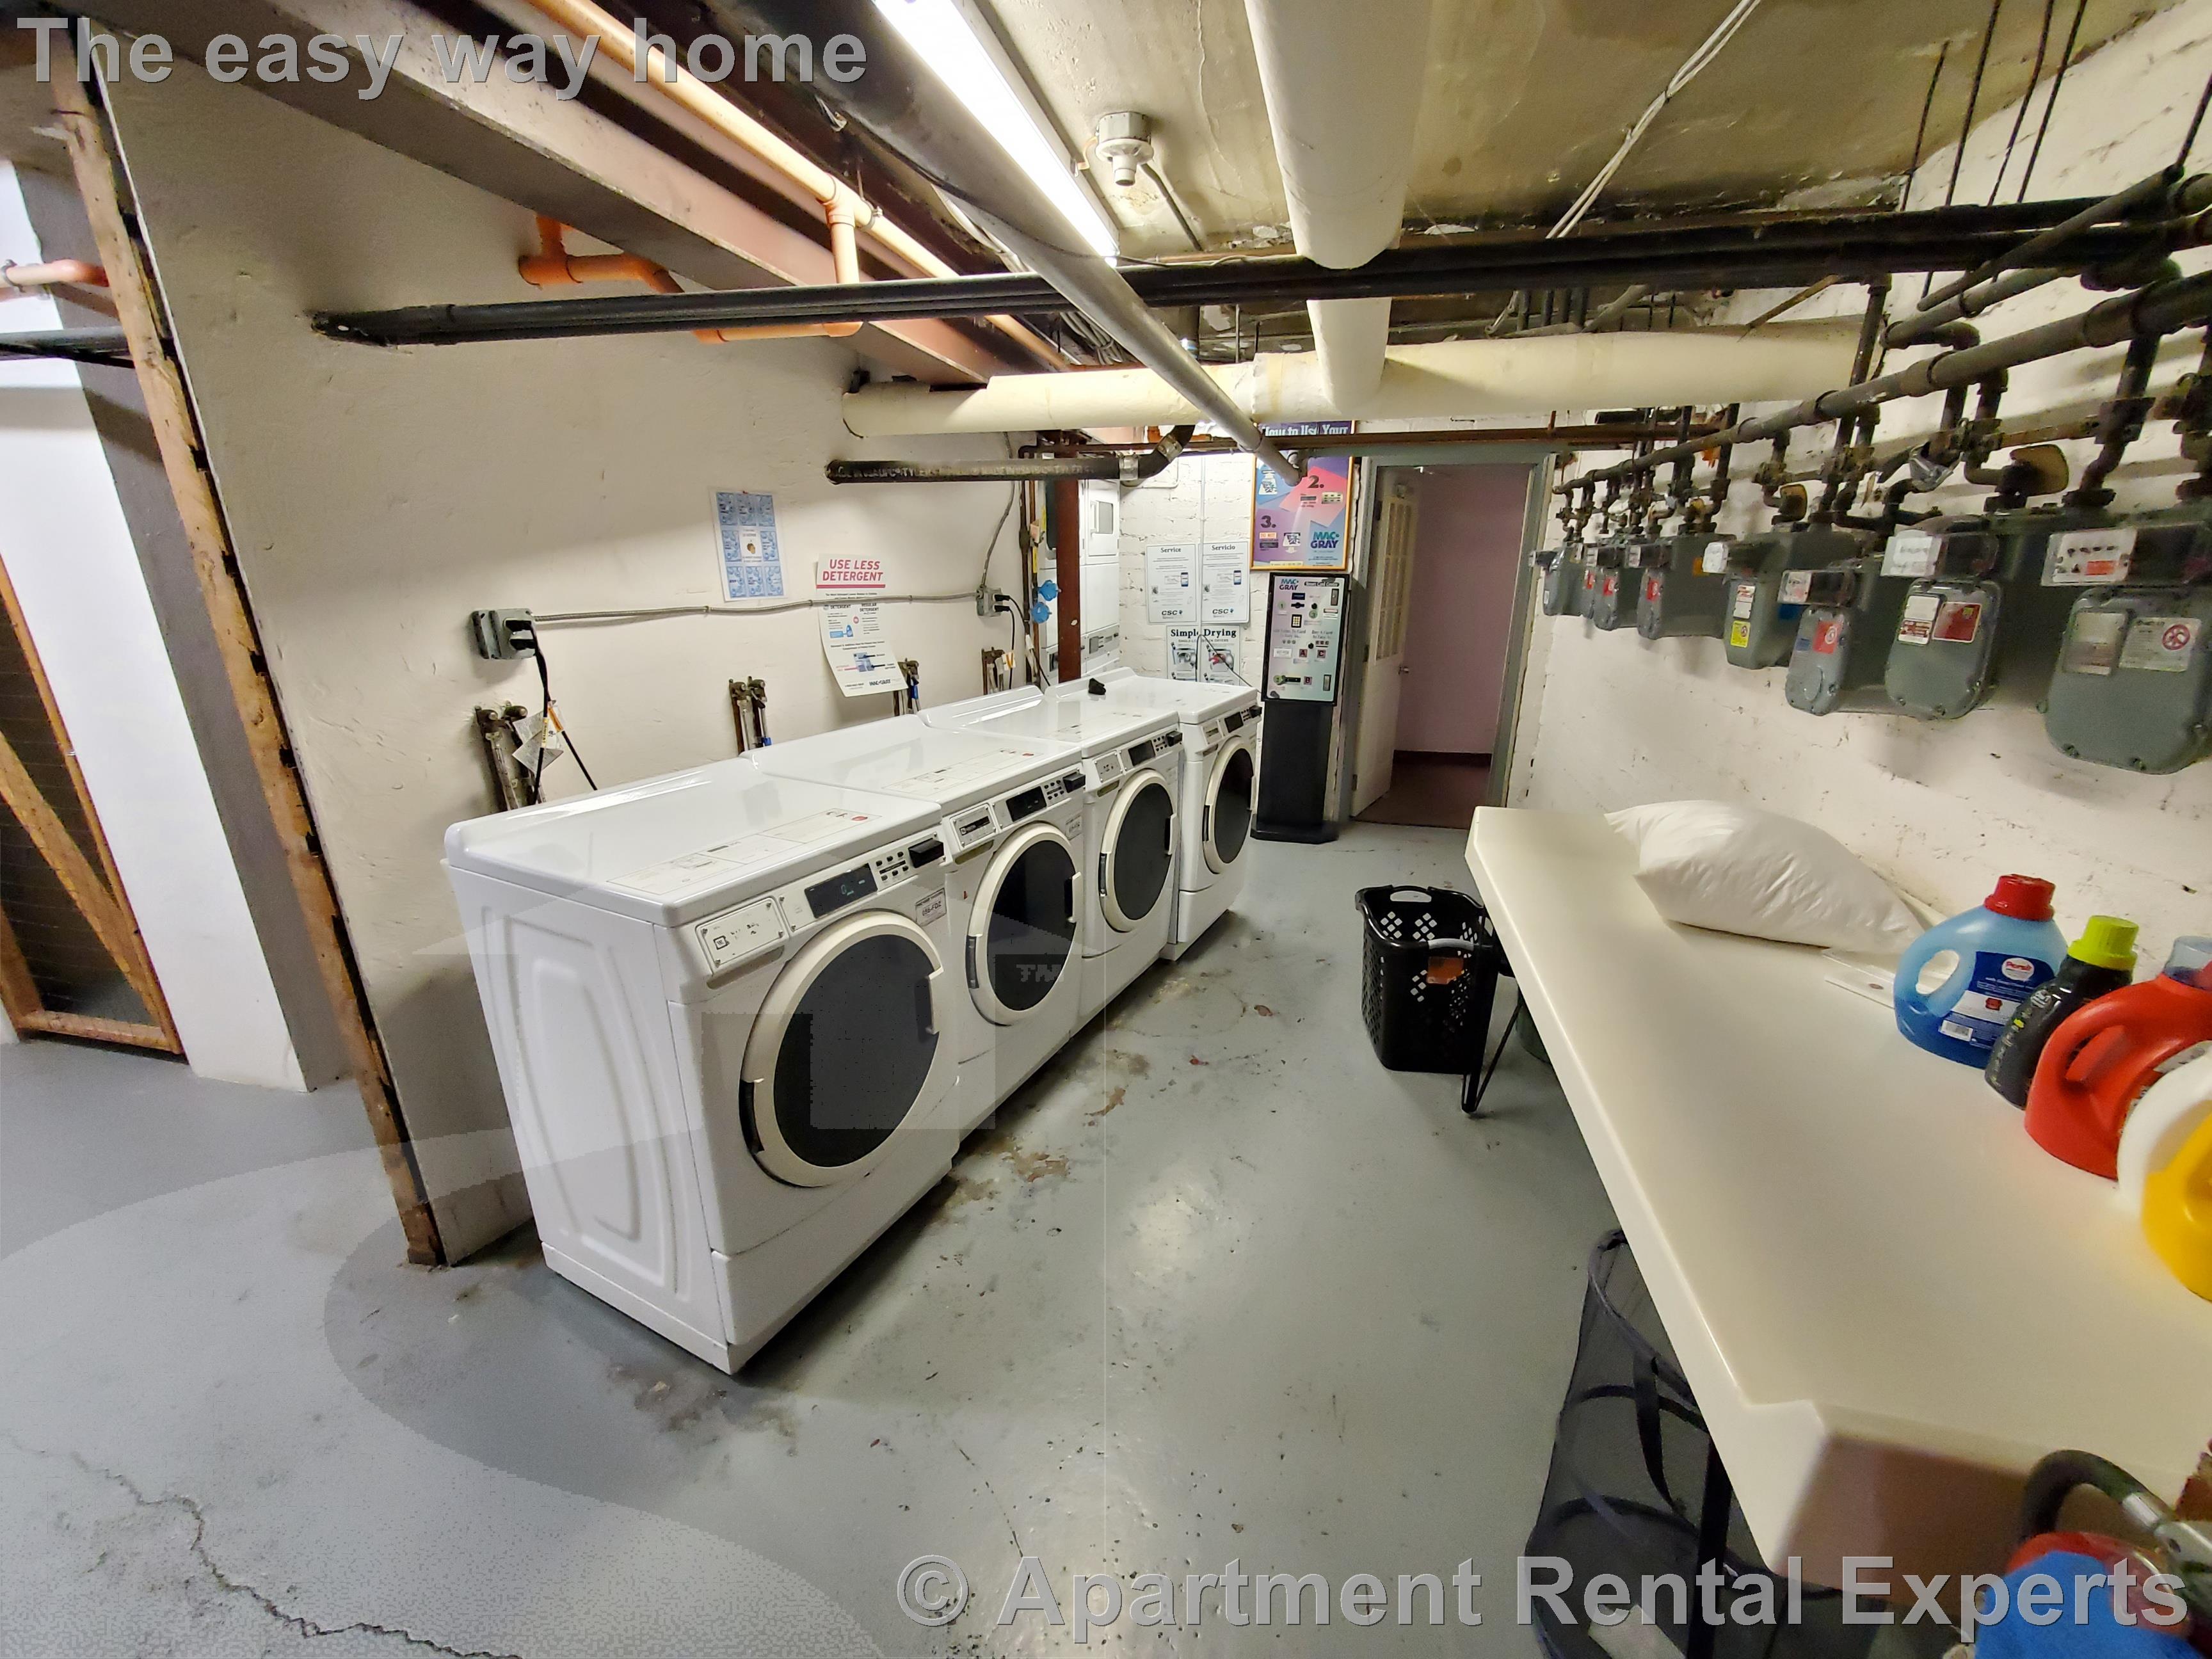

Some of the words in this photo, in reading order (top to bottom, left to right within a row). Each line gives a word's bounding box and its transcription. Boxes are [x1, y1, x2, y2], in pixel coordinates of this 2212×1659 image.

[1310, 540, 1339, 549] GRAY
[830, 559, 851, 569] USE
[854, 560, 881, 570] LESS
[822, 571, 883, 581] DETERGENT
[1171, 629, 1199, 638] Simpl
[1204, 629, 1237, 638] Drying
